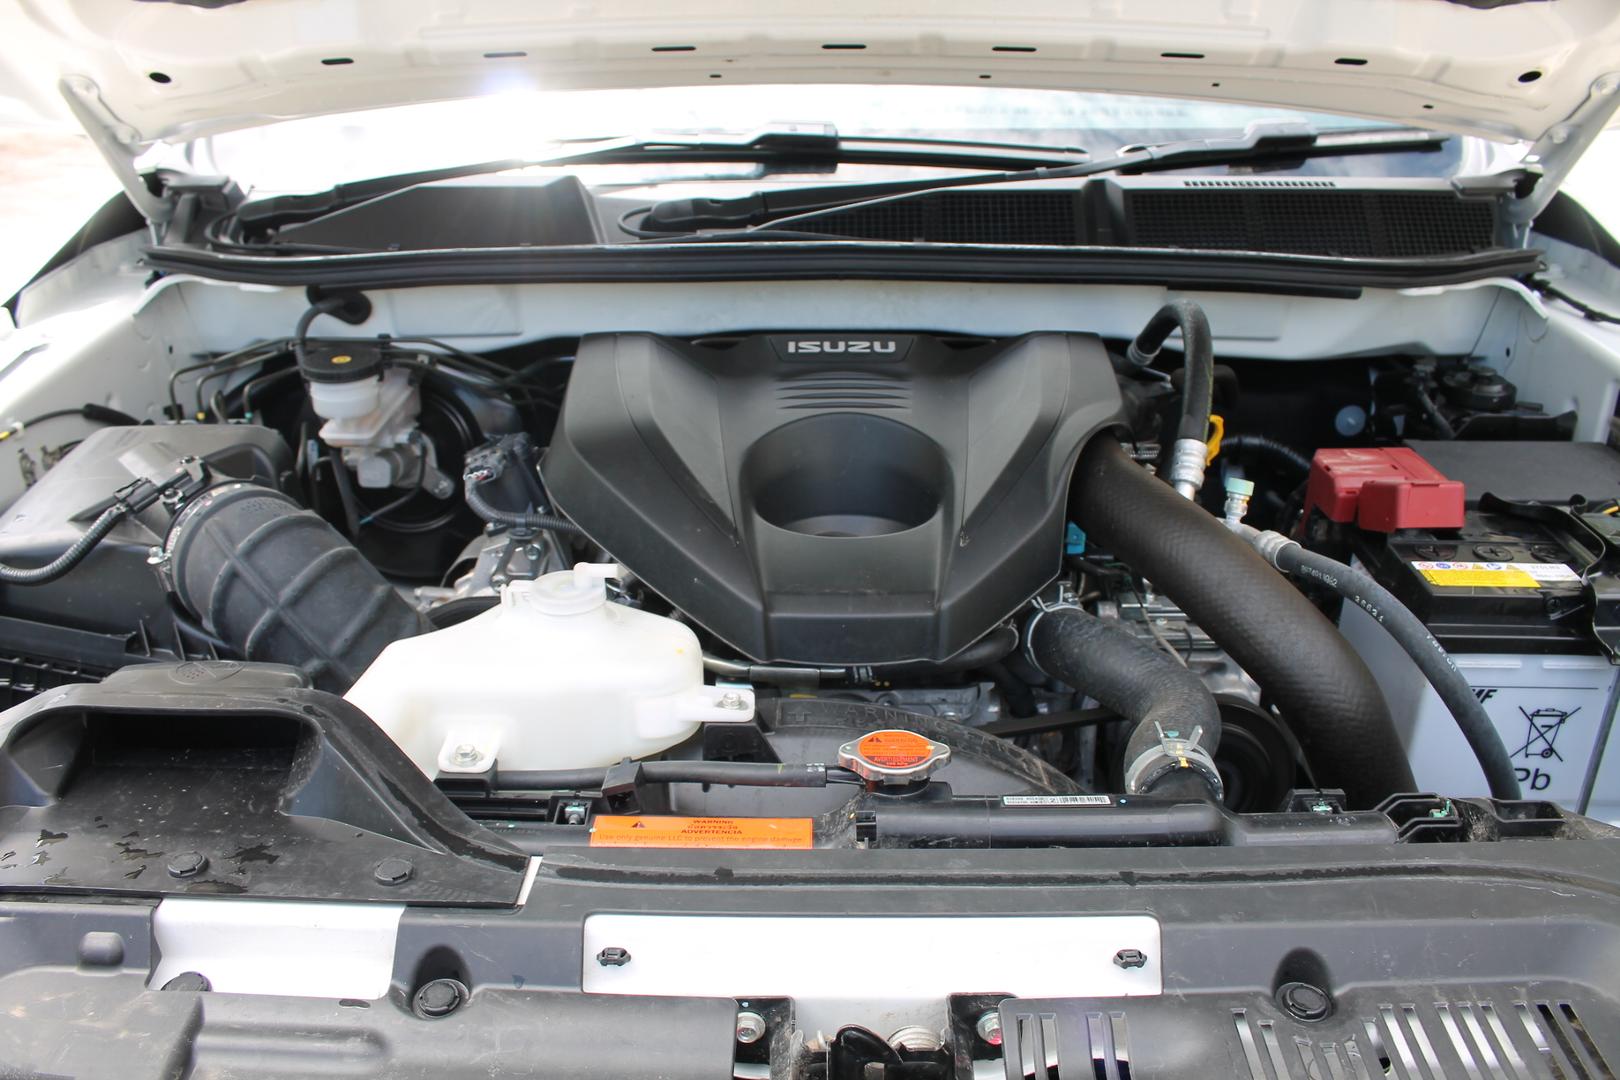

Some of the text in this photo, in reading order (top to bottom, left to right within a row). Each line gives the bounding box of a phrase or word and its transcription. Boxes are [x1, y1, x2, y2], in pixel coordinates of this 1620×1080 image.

[788, 341, 896, 353] ISUZU
[1514, 768, 1551, 790] Pb
[616, 834, 632, 842] only
